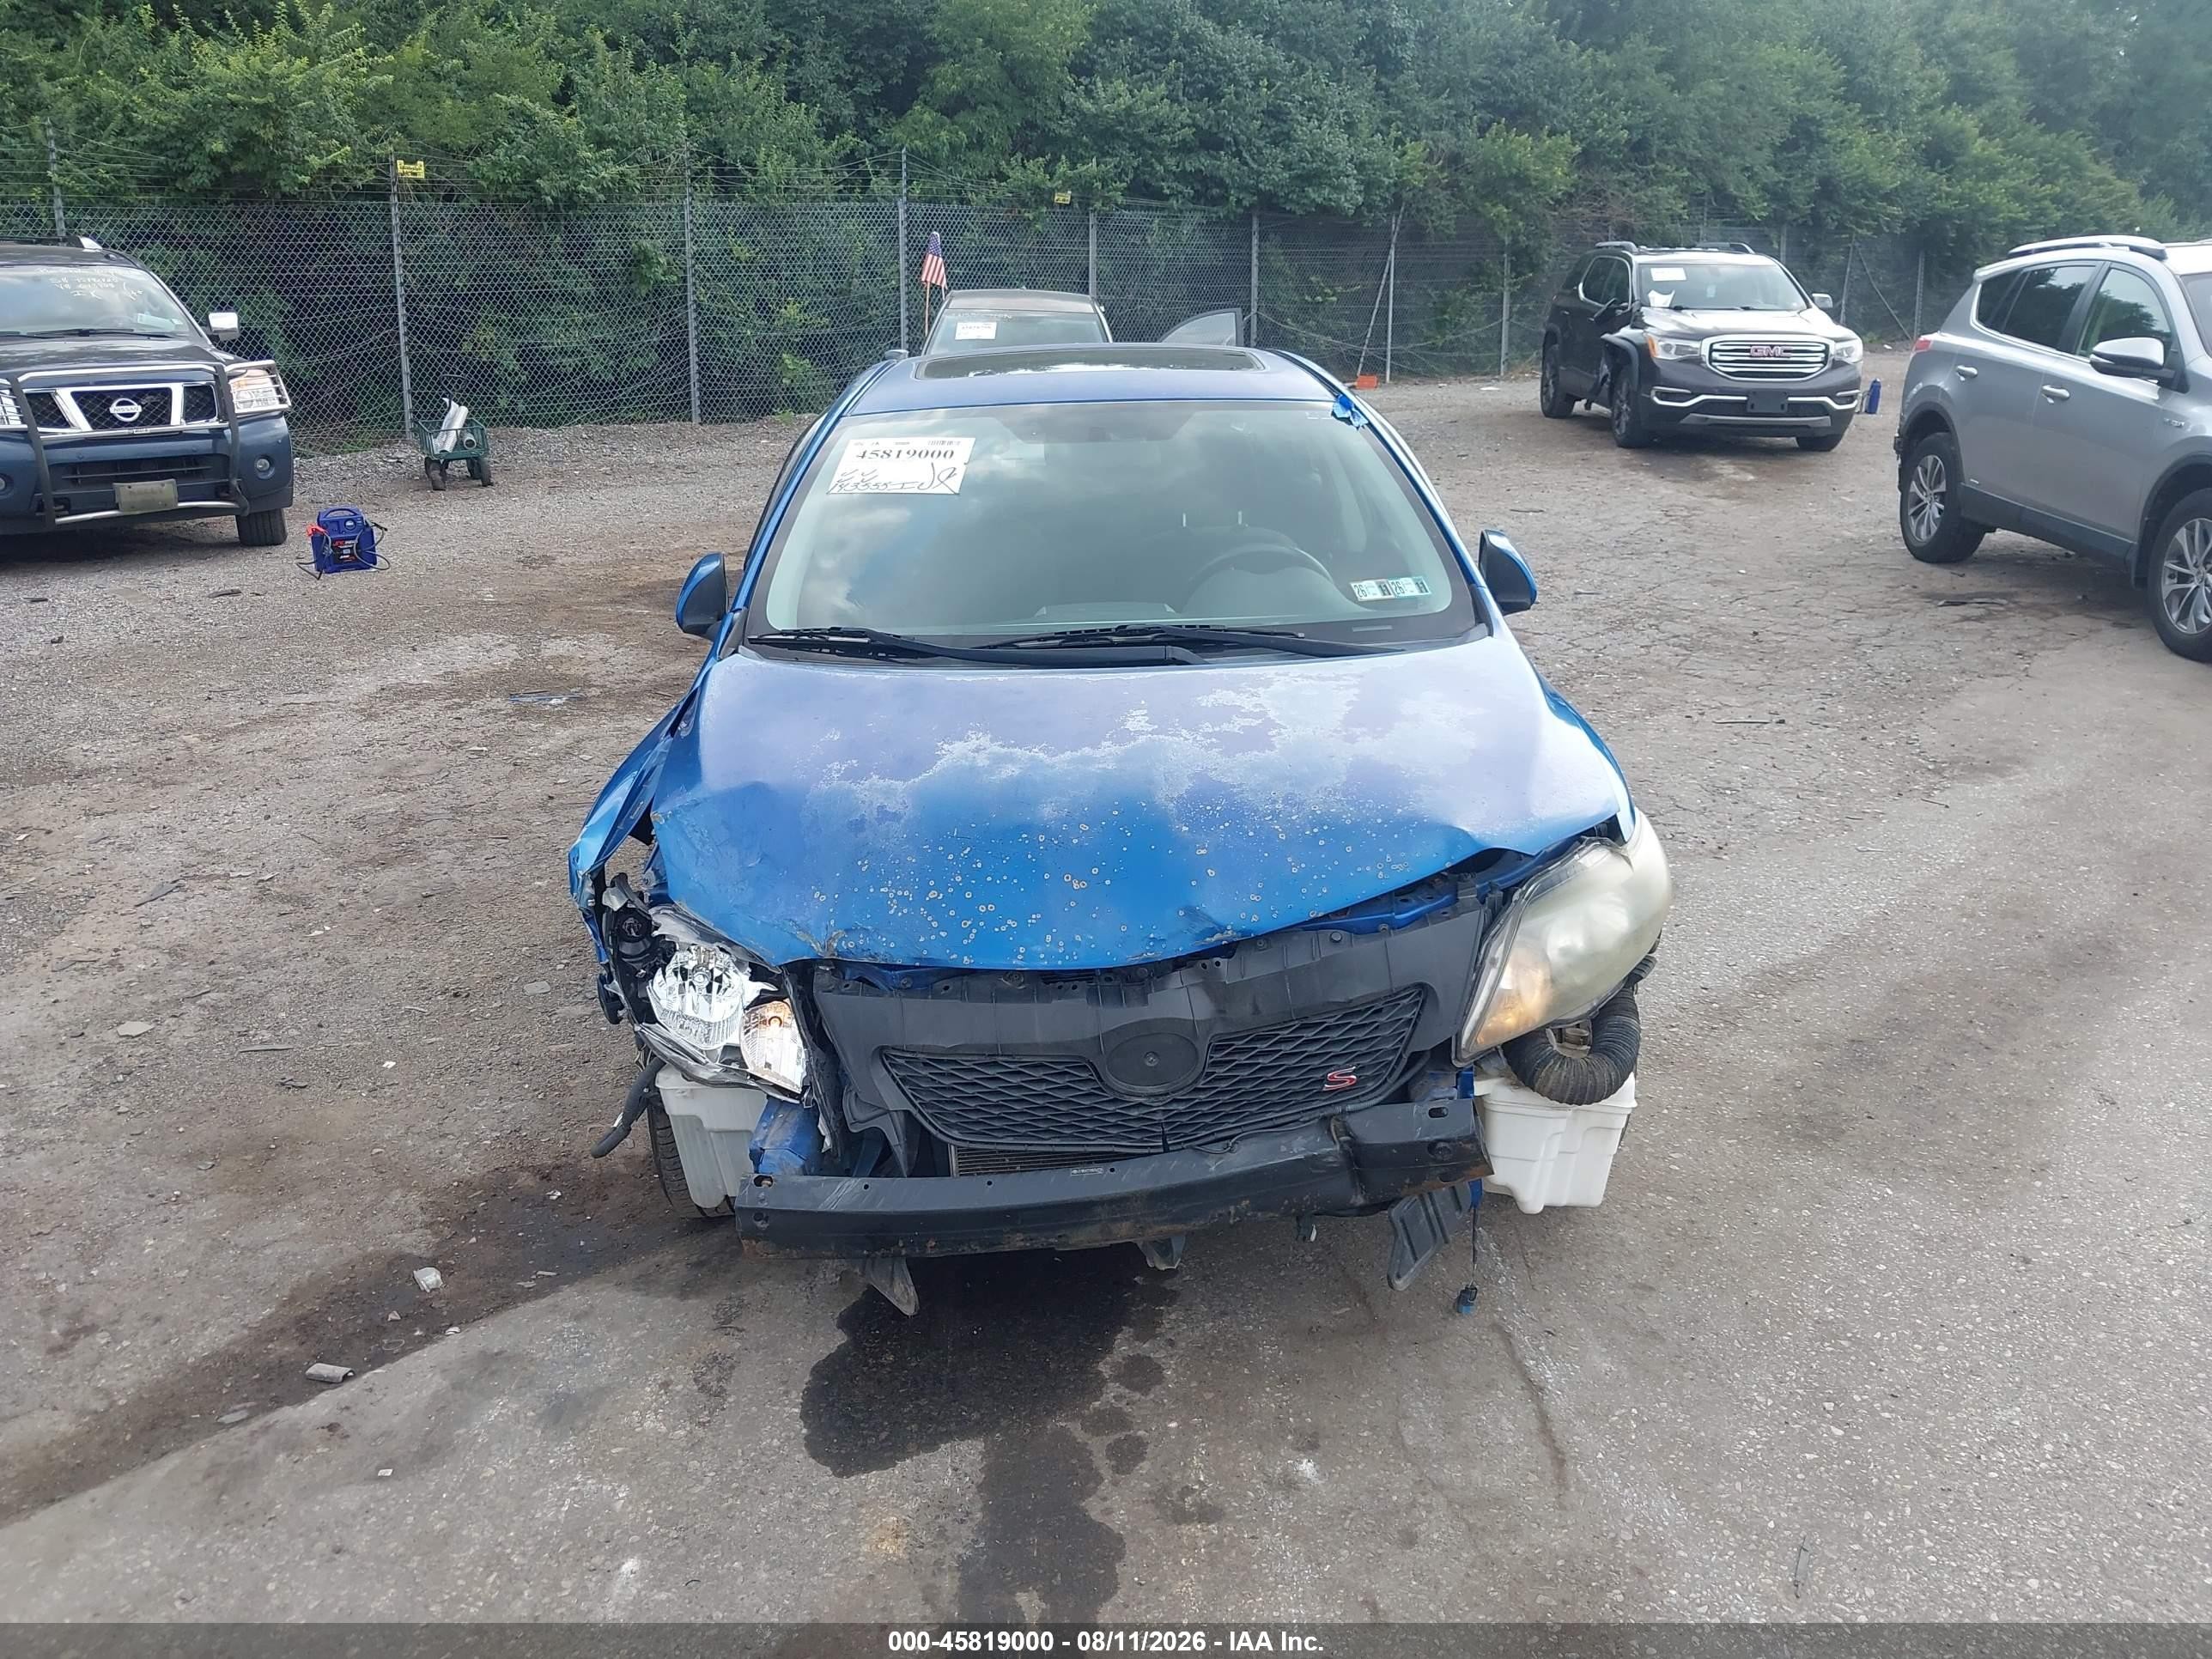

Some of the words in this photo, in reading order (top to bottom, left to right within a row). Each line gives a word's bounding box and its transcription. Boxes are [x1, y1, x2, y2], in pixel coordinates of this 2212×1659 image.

[1750, 345, 1793, 357] GMC
[856, 449, 955, 459] 45819000
[1322, 1066, 1357, 1091] S
